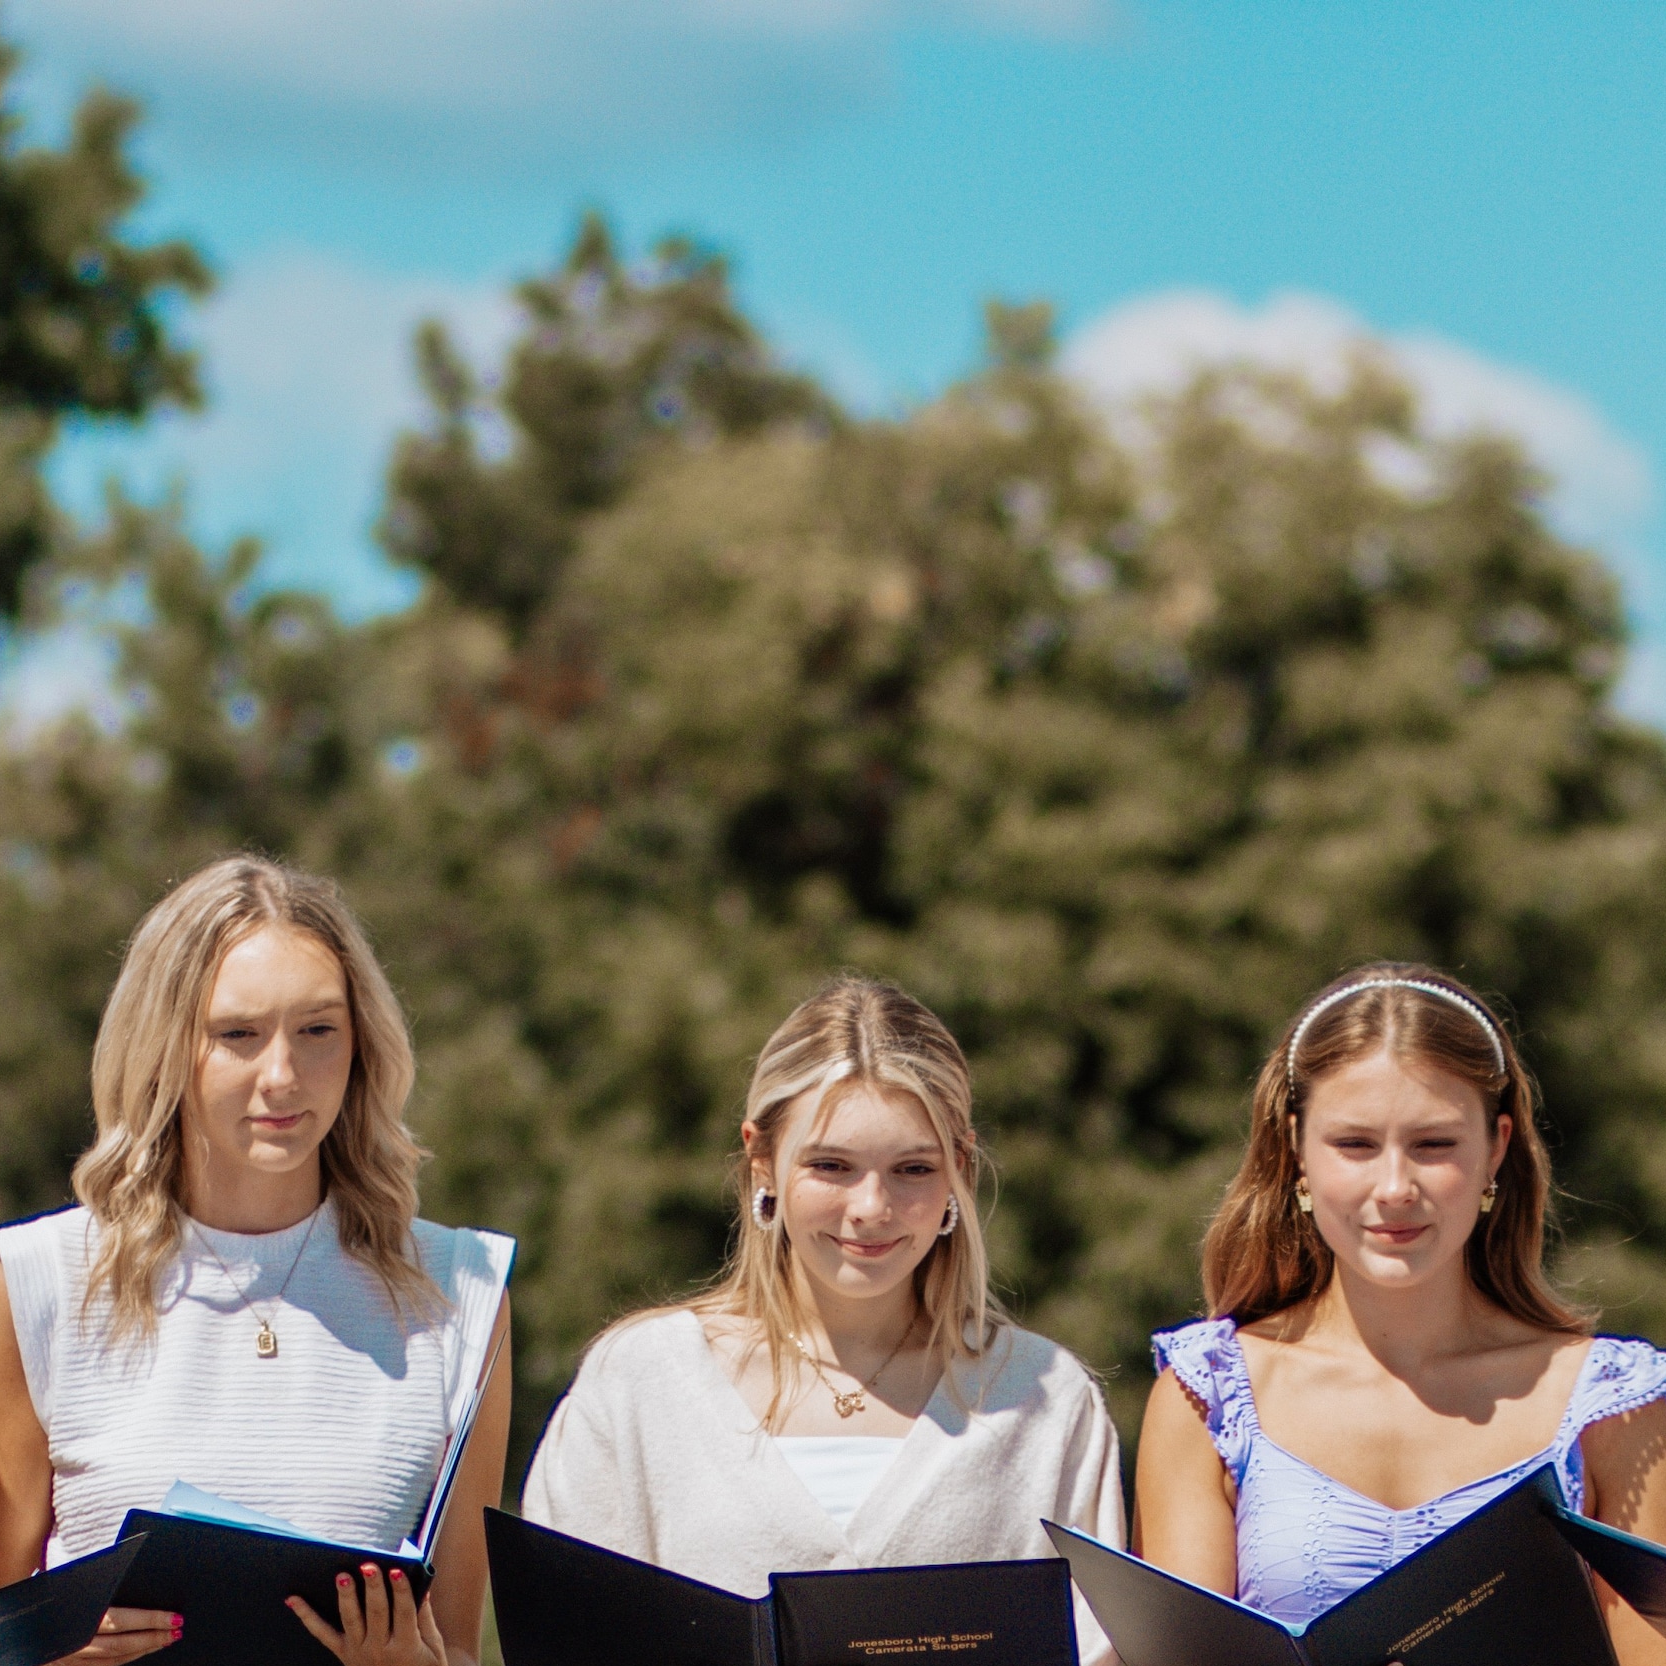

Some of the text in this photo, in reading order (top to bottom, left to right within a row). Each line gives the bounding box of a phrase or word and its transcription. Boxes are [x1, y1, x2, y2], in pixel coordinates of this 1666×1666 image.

[1386, 1571, 1506, 1655] Jonesboro High School
[1401, 1588, 1494, 1653] Camerata Singers
[848, 1632, 994, 1649] Jonesboro High School
[865, 1641, 978, 1655] Camerata Singers
